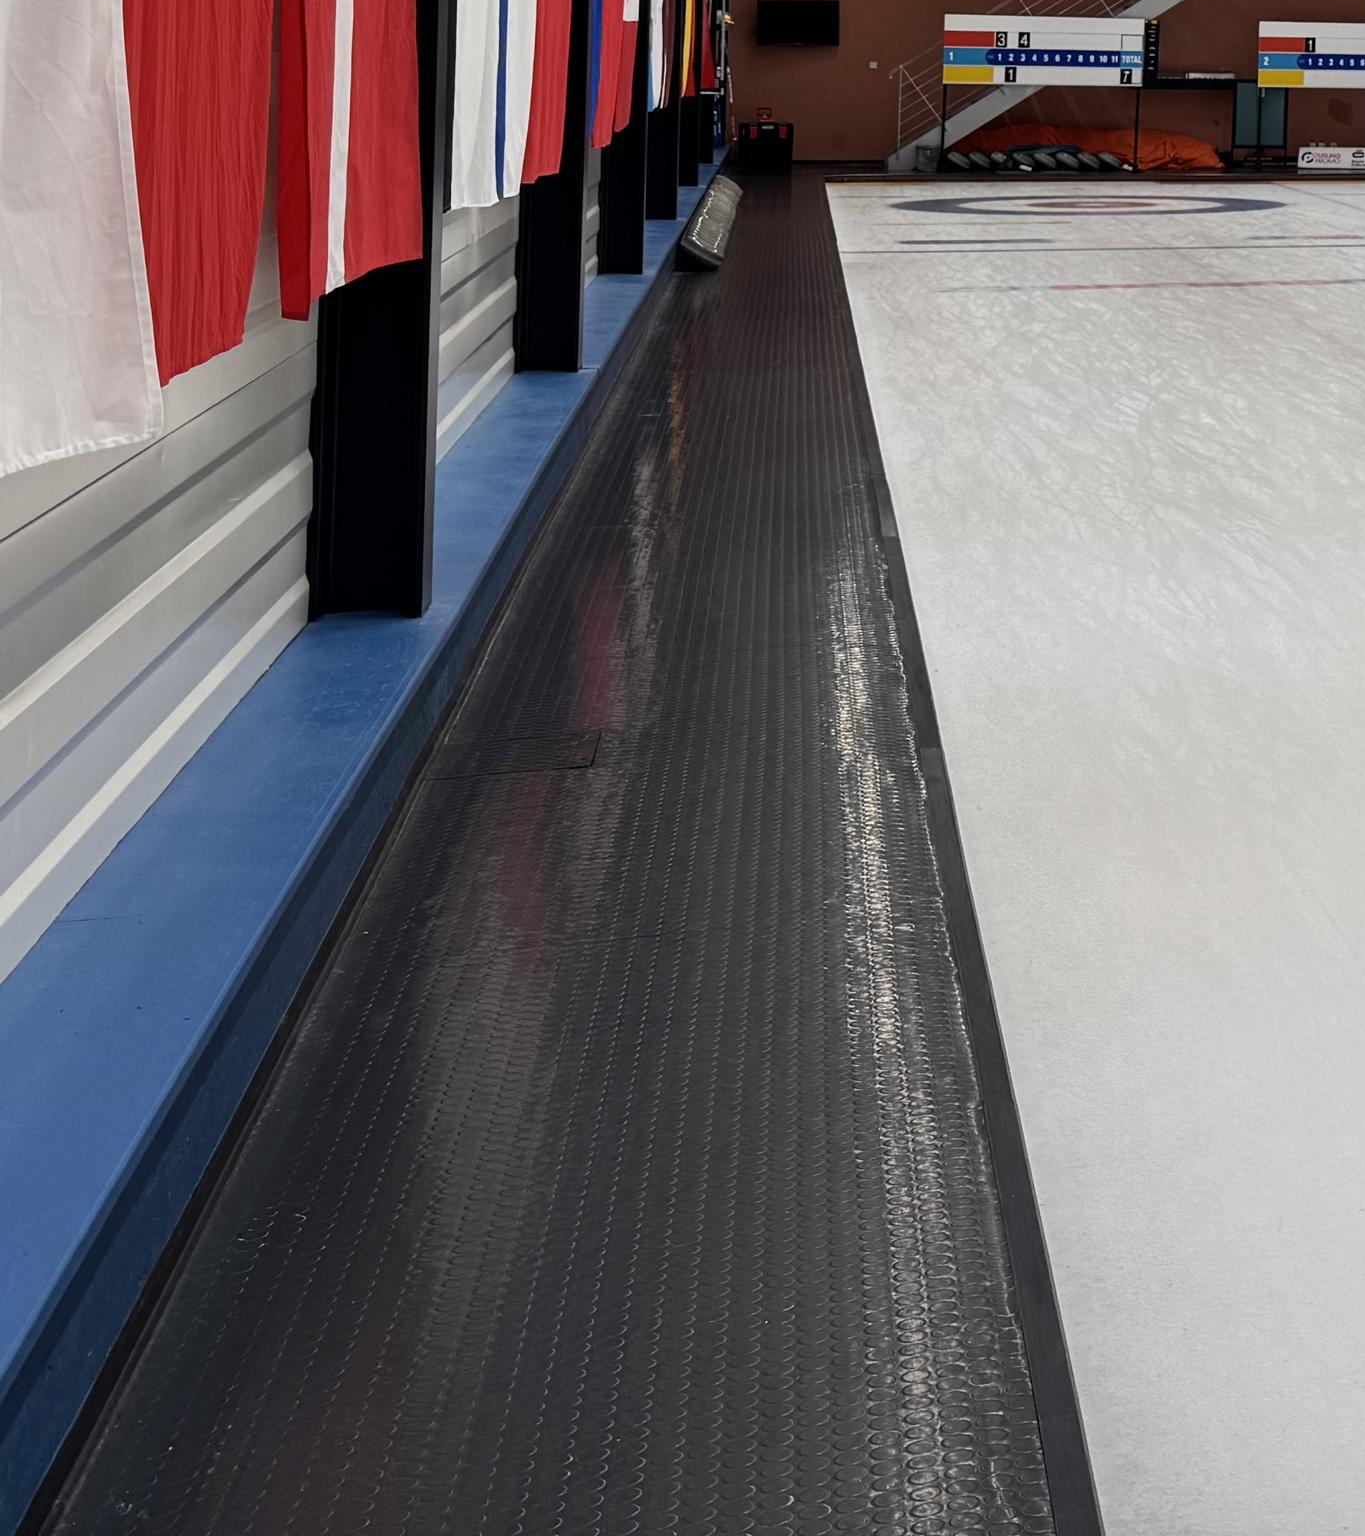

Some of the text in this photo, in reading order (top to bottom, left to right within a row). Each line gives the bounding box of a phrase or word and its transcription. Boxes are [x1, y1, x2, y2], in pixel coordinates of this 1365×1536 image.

[997, 34, 1028, 47] 3 4
[1308, 39, 1313, 51] 1
[949, 51, 954, 61] 1
[1099, 55, 1108, 63] 10
[1111, 55, 1119, 63] 11
[1121, 55, 1142, 64] TOTAL
[1263, 56, 1269, 66] 2
[1008, 68, 1014, 81] 1
